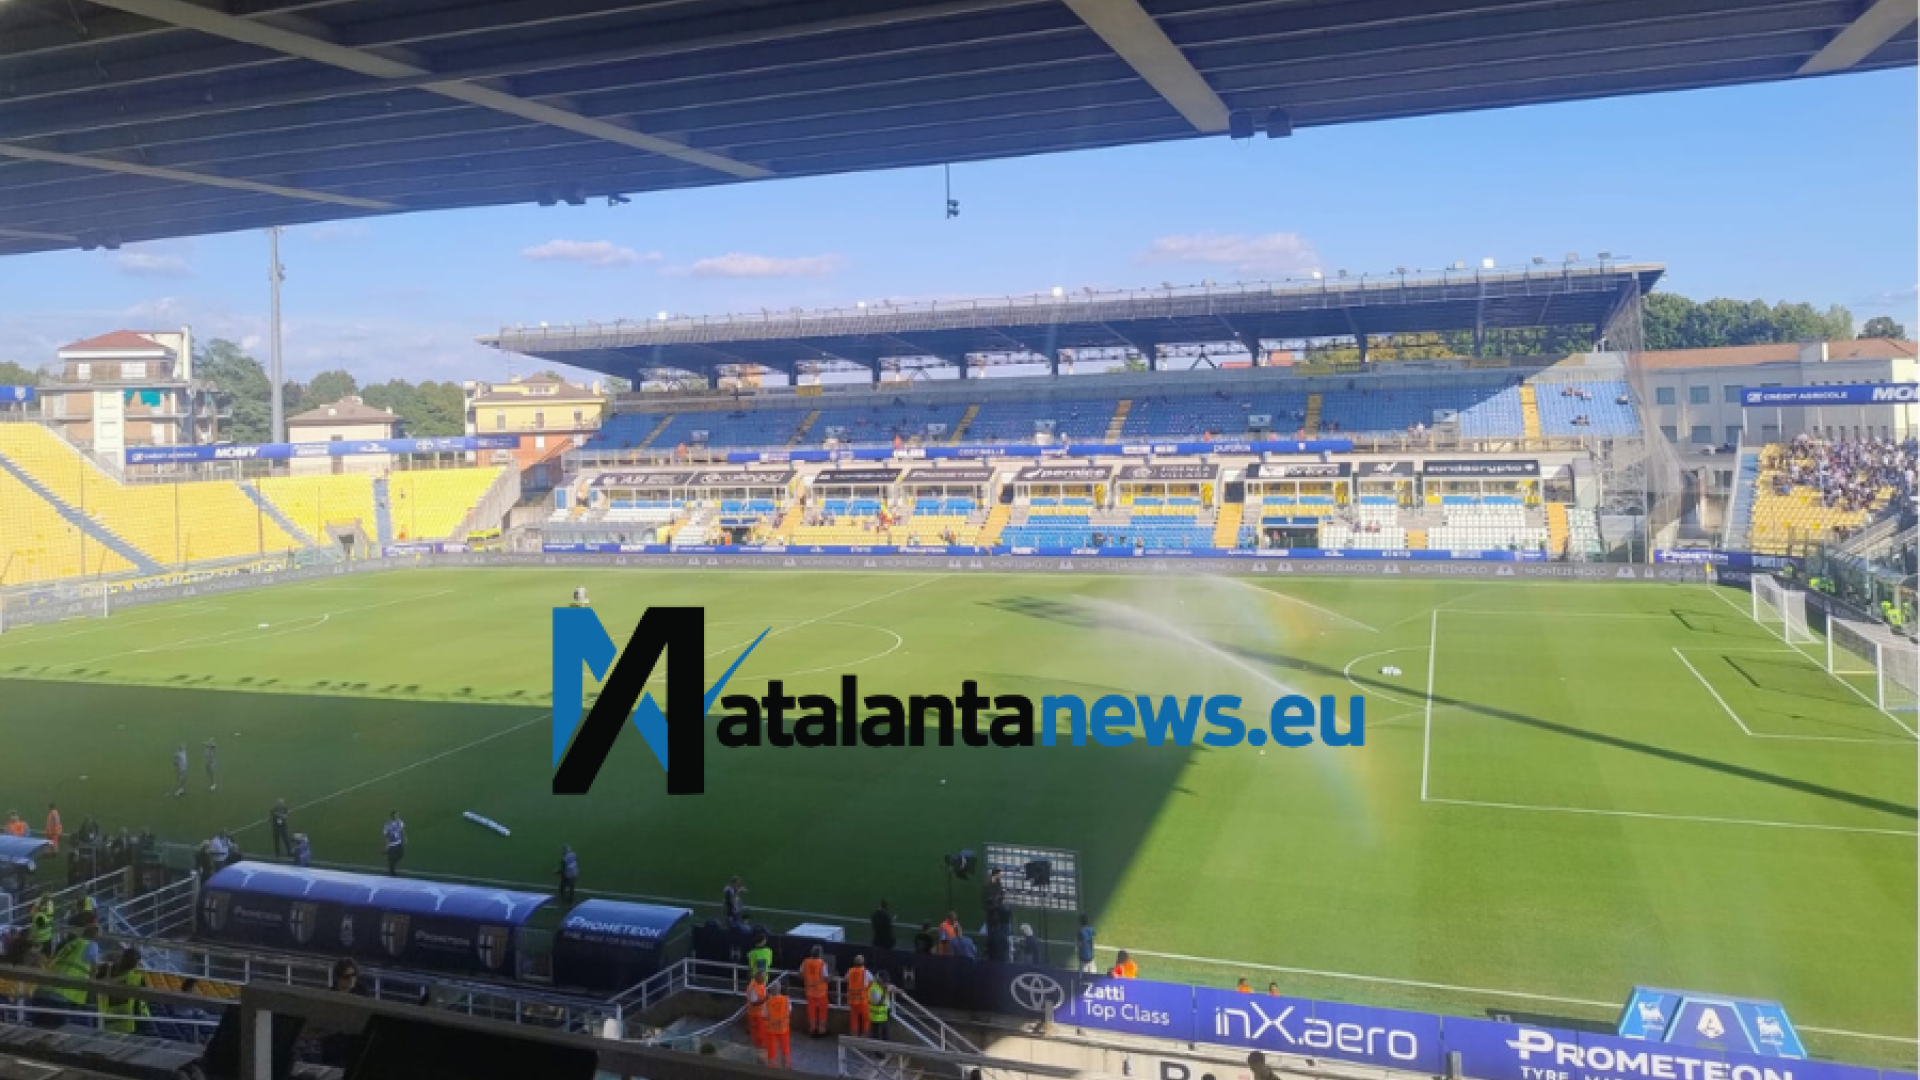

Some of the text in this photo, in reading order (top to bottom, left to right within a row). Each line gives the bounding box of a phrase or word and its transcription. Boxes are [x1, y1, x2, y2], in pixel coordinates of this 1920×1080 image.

[1083, 982, 1125, 1002] Zatti
[1083, 999, 1170, 1026] Top Class
[1215, 1001, 1418, 1060] inX.aero
